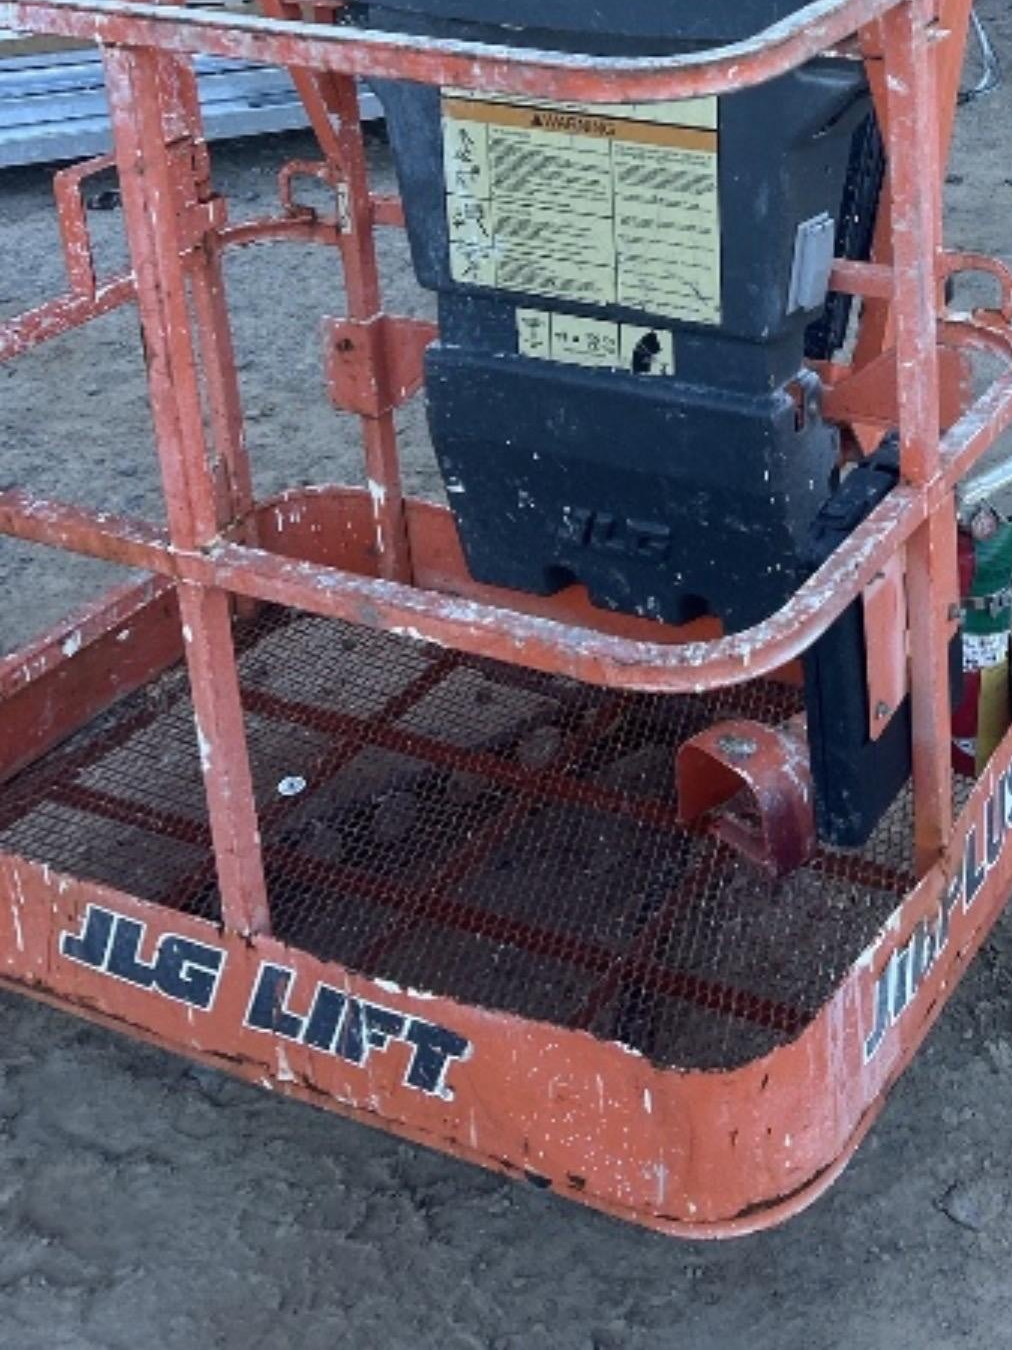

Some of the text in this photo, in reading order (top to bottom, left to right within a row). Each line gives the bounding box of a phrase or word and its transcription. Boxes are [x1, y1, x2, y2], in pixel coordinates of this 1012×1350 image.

[542, 113, 617, 137] WARNING
[60, 902, 473, 1098] JLG LIFT
